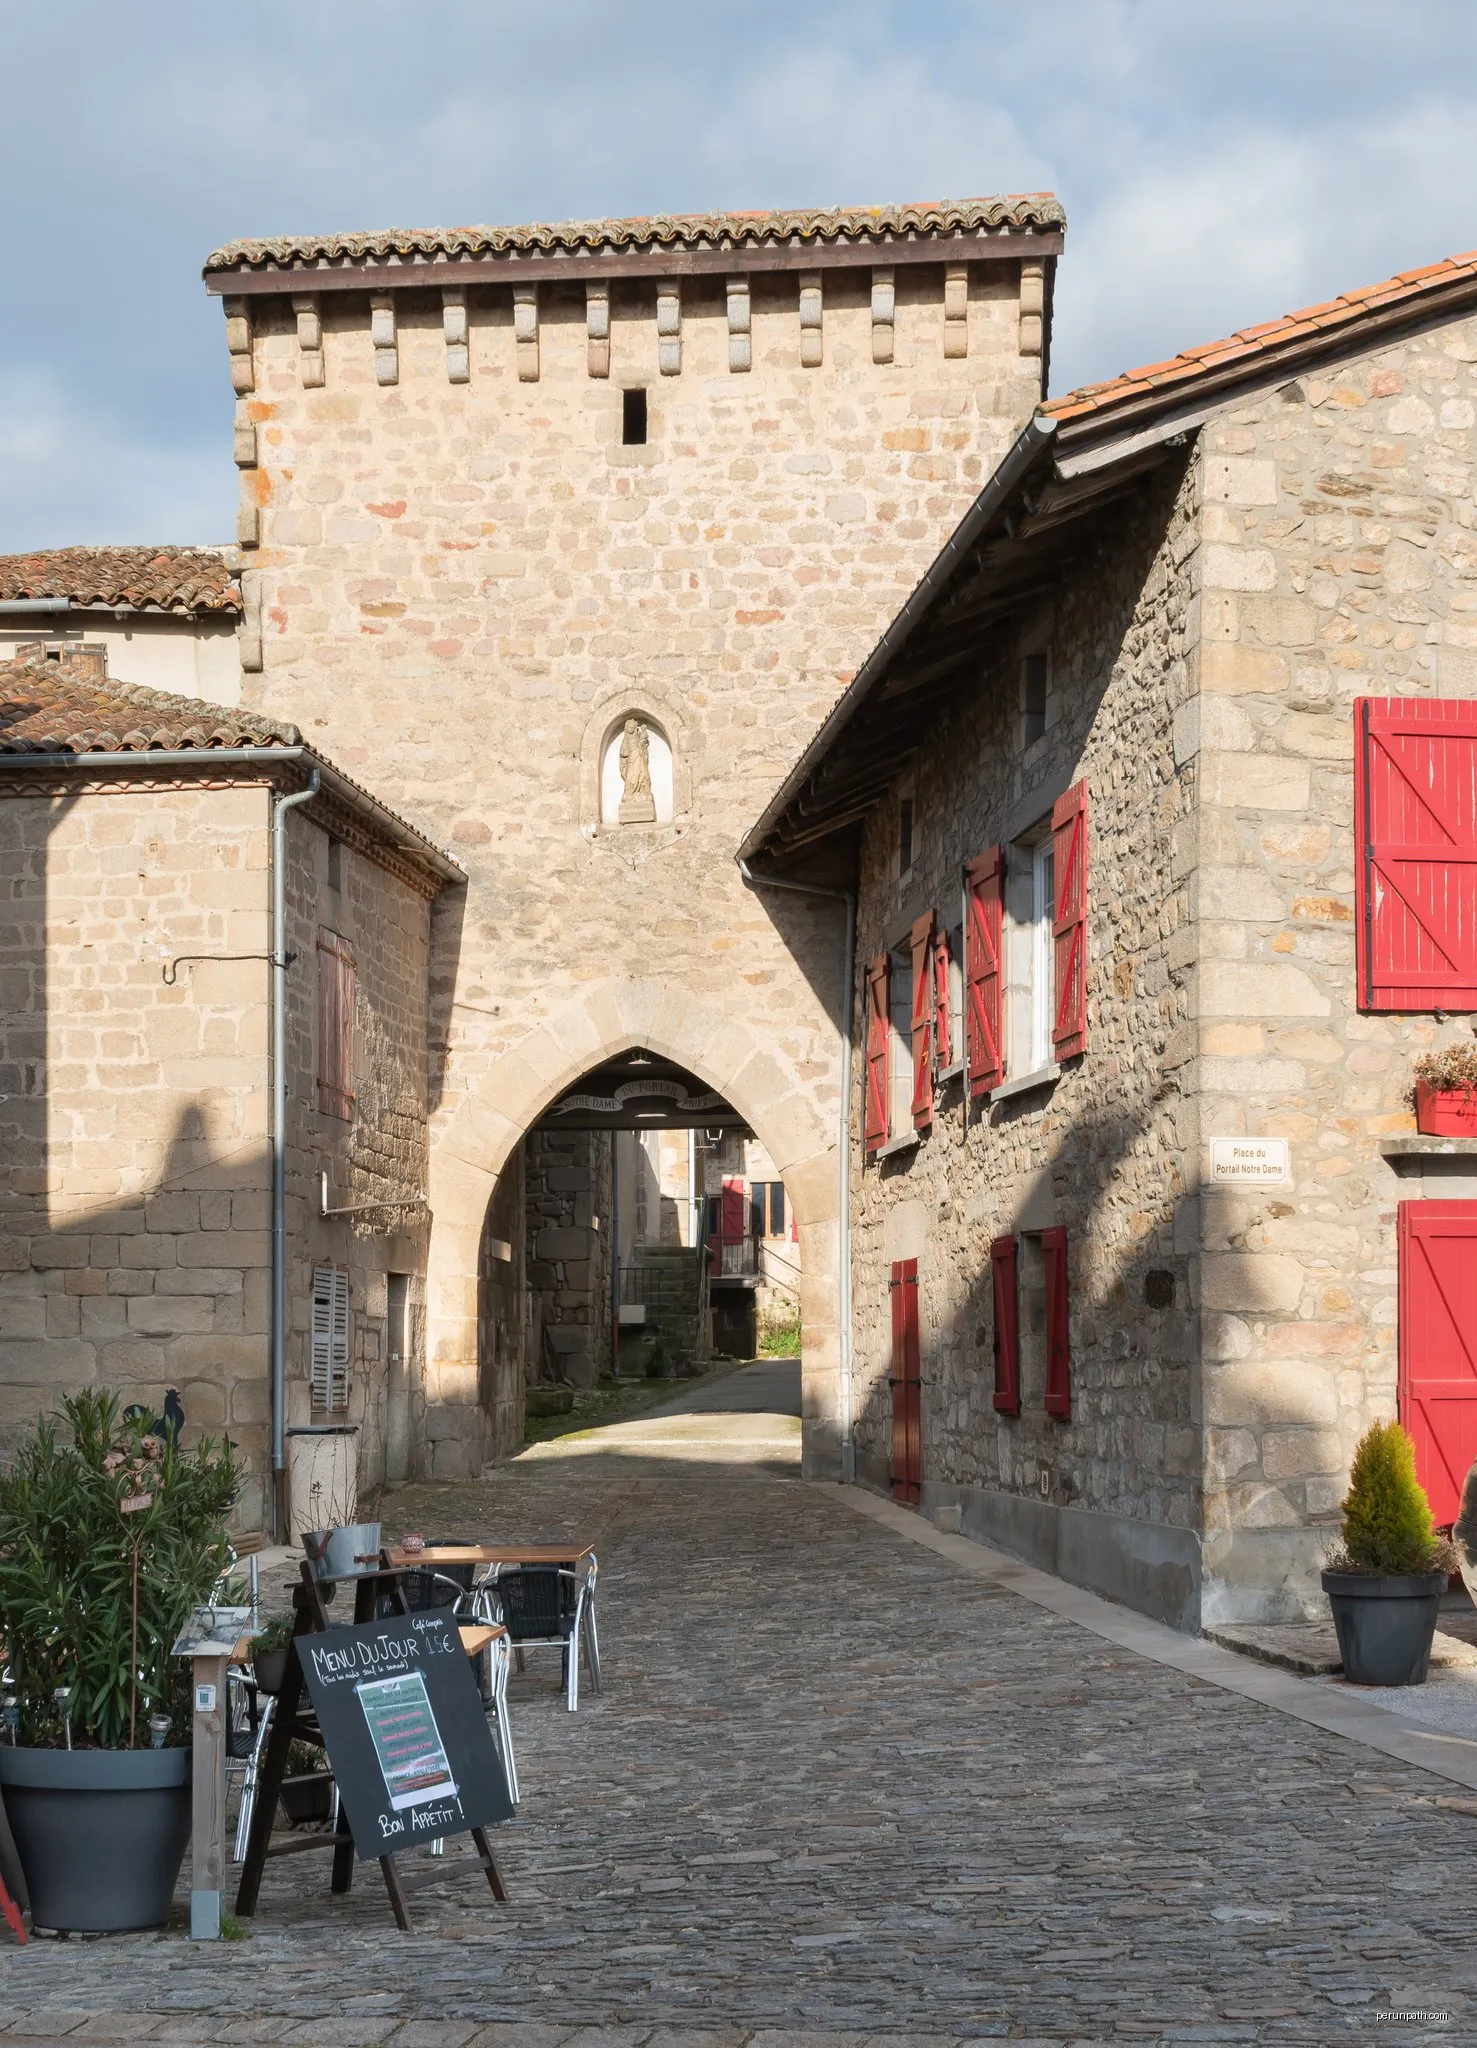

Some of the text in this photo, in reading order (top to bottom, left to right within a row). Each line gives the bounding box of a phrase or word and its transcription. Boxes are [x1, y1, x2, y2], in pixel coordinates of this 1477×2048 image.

[565, 1096, 590, 1108] NOTRE
[593, 1098, 617, 1109] DAME
[623, 1083, 635, 1096] DU
[638, 1082, 677, 1096] PORTAIL
[1233, 1148, 1266, 1158] Place du
[1216, 1164, 1282, 1174] Portail Notre Dame
[311, 1647, 356, 1683] MENU
